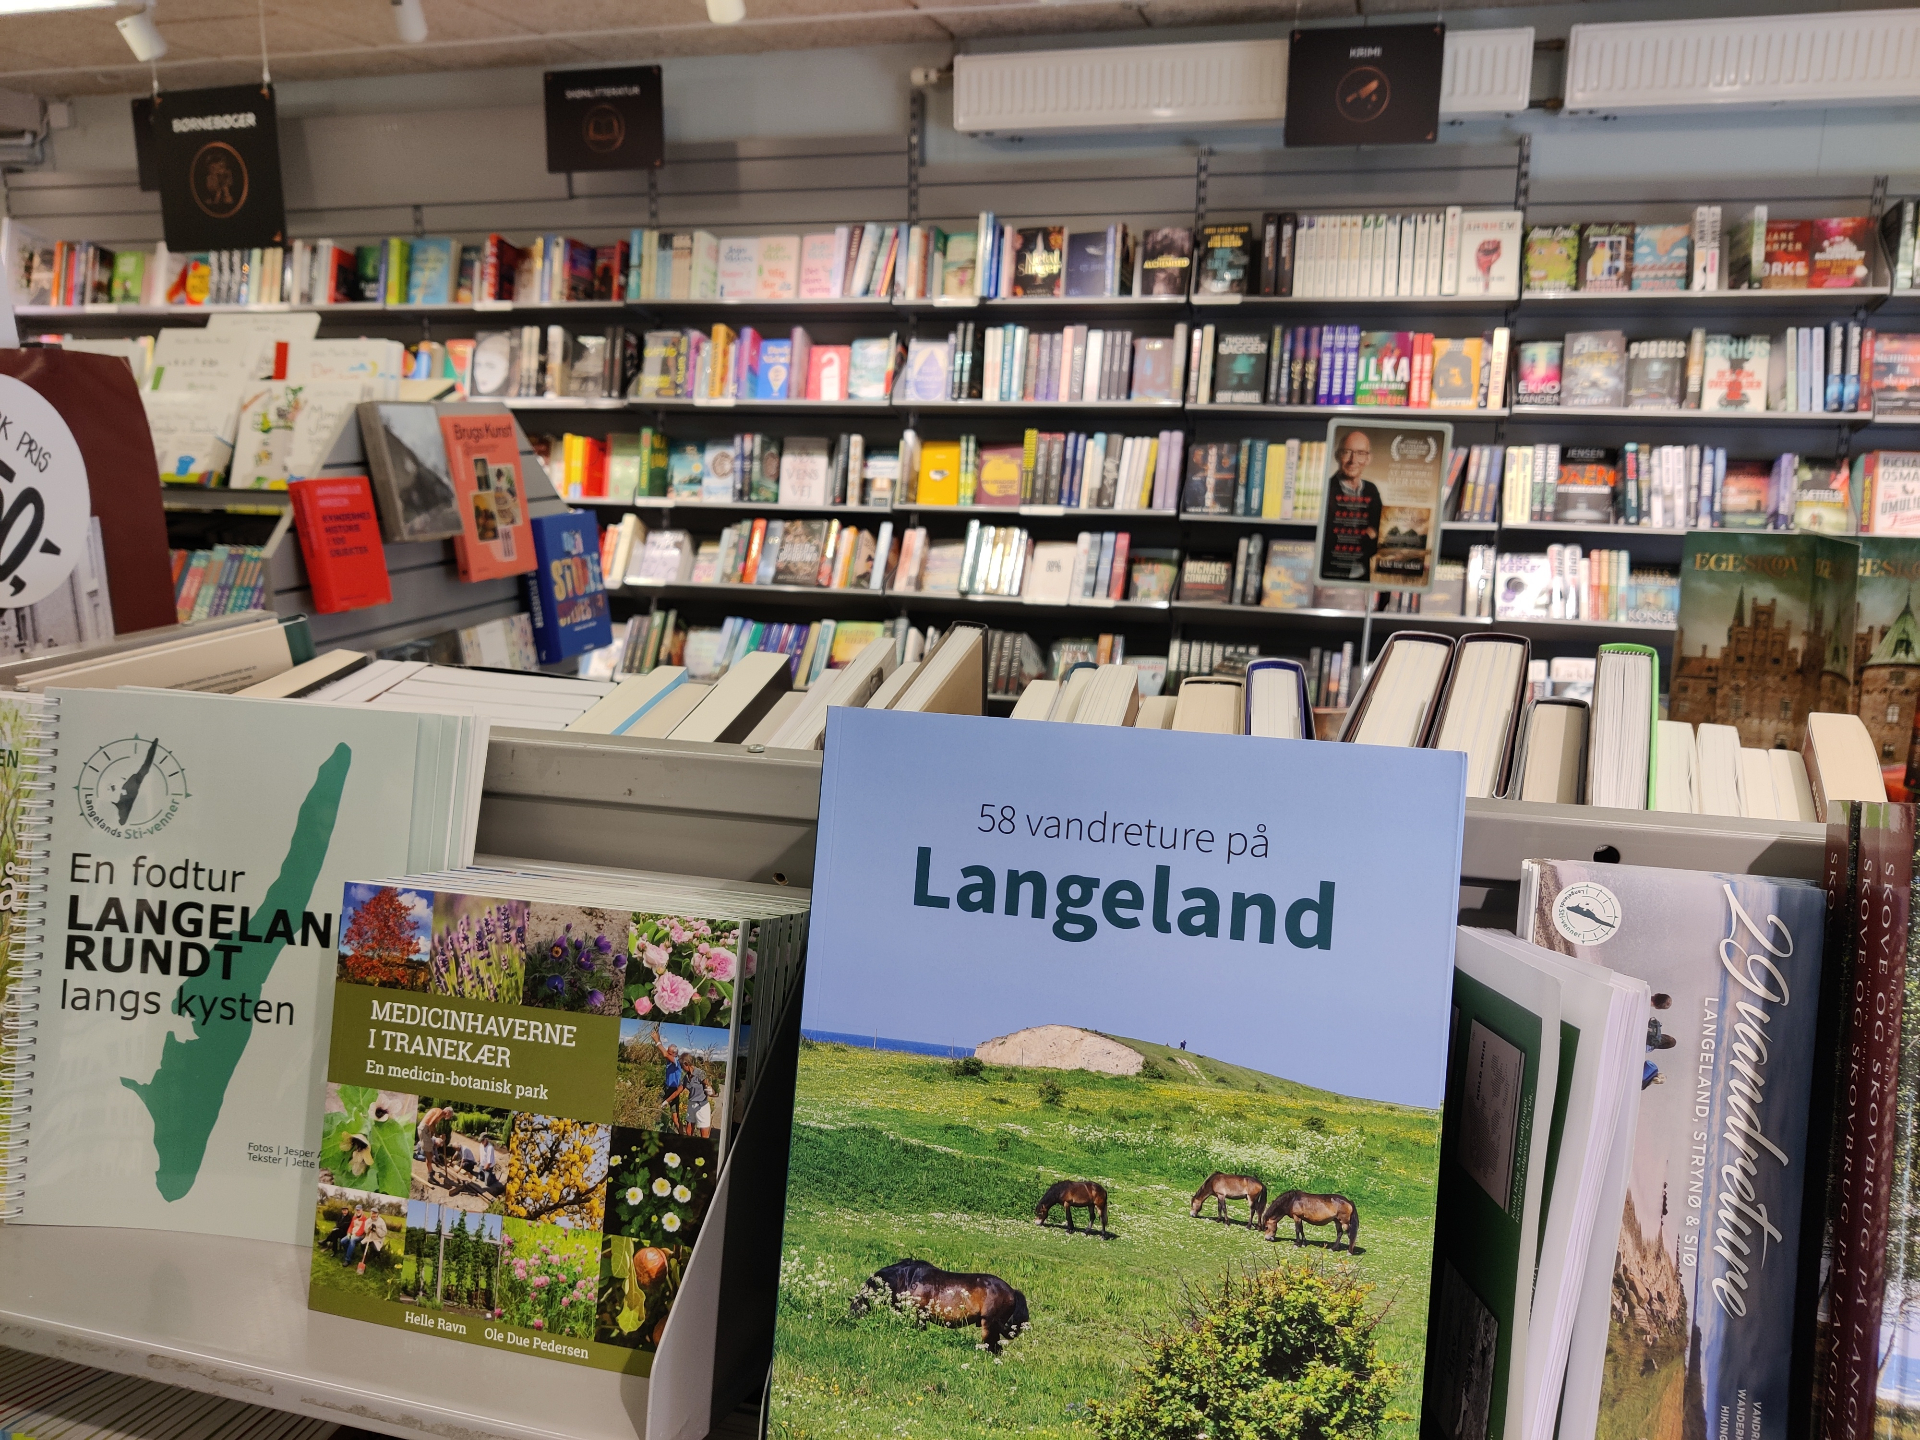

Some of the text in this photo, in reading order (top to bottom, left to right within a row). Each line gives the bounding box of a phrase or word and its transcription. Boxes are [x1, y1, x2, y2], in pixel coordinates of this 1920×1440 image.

[1357, 356, 1410, 383] ILKA
[16, 431, 51, 473] PRIS
[453, 421, 513, 443] Brugs Kunst
[1883, 457, 1920, 468] RICHA
[1184, 573, 1226, 584] CONNELLY
[1185, 561, 1227, 575] MICHAEL
[85, 793, 180, 839] Langelands Sti-venner
[977, 803, 1270, 865] 58 vandreture på
[70, 853, 246, 893] En fodtur
[67, 894, 342, 949] LANGELAN
[913, 846, 1336, 951] Langeland
[1857, 858, 1873, 964] SKOVE
[1878, 862, 1895, 975] SKOVE
[65, 934, 243, 981] RUNDT
[61, 978, 295, 1026] langs kysten
[370, 1000, 578, 1047] MEDICINHAVERNE
[1853, 980, 1864, 1028] OG
[1873, 991, 1887, 1043] OG
[368, 1028, 511, 1068] I TRANEKÆR
[365, 1060, 549, 1100] En medicin-botanisk park
[1711, 884, 1794, 1319] 29 vandreture
[248, 1142, 274, 1153] Fotos
[284, 1146, 315, 1159] Jesper
[1681, 996, 1720, 1268] LANGELAND, STRYNØ & SIØ
[1840, 1043, 1862, 1224] SKOVBRUG
[1859, 1058, 1882, 1252] SKOVBRUG
[247, 1152, 316, 1169] Tekster Jette
[1836, 1239, 1848, 1276] PÅ
[1855, 1265, 1869, 1306] PÅ
[405, 1311, 589, 1359] Helle Ravn Ole Due Pedersen
[1751, 1401, 1762, 1440] VANDR
